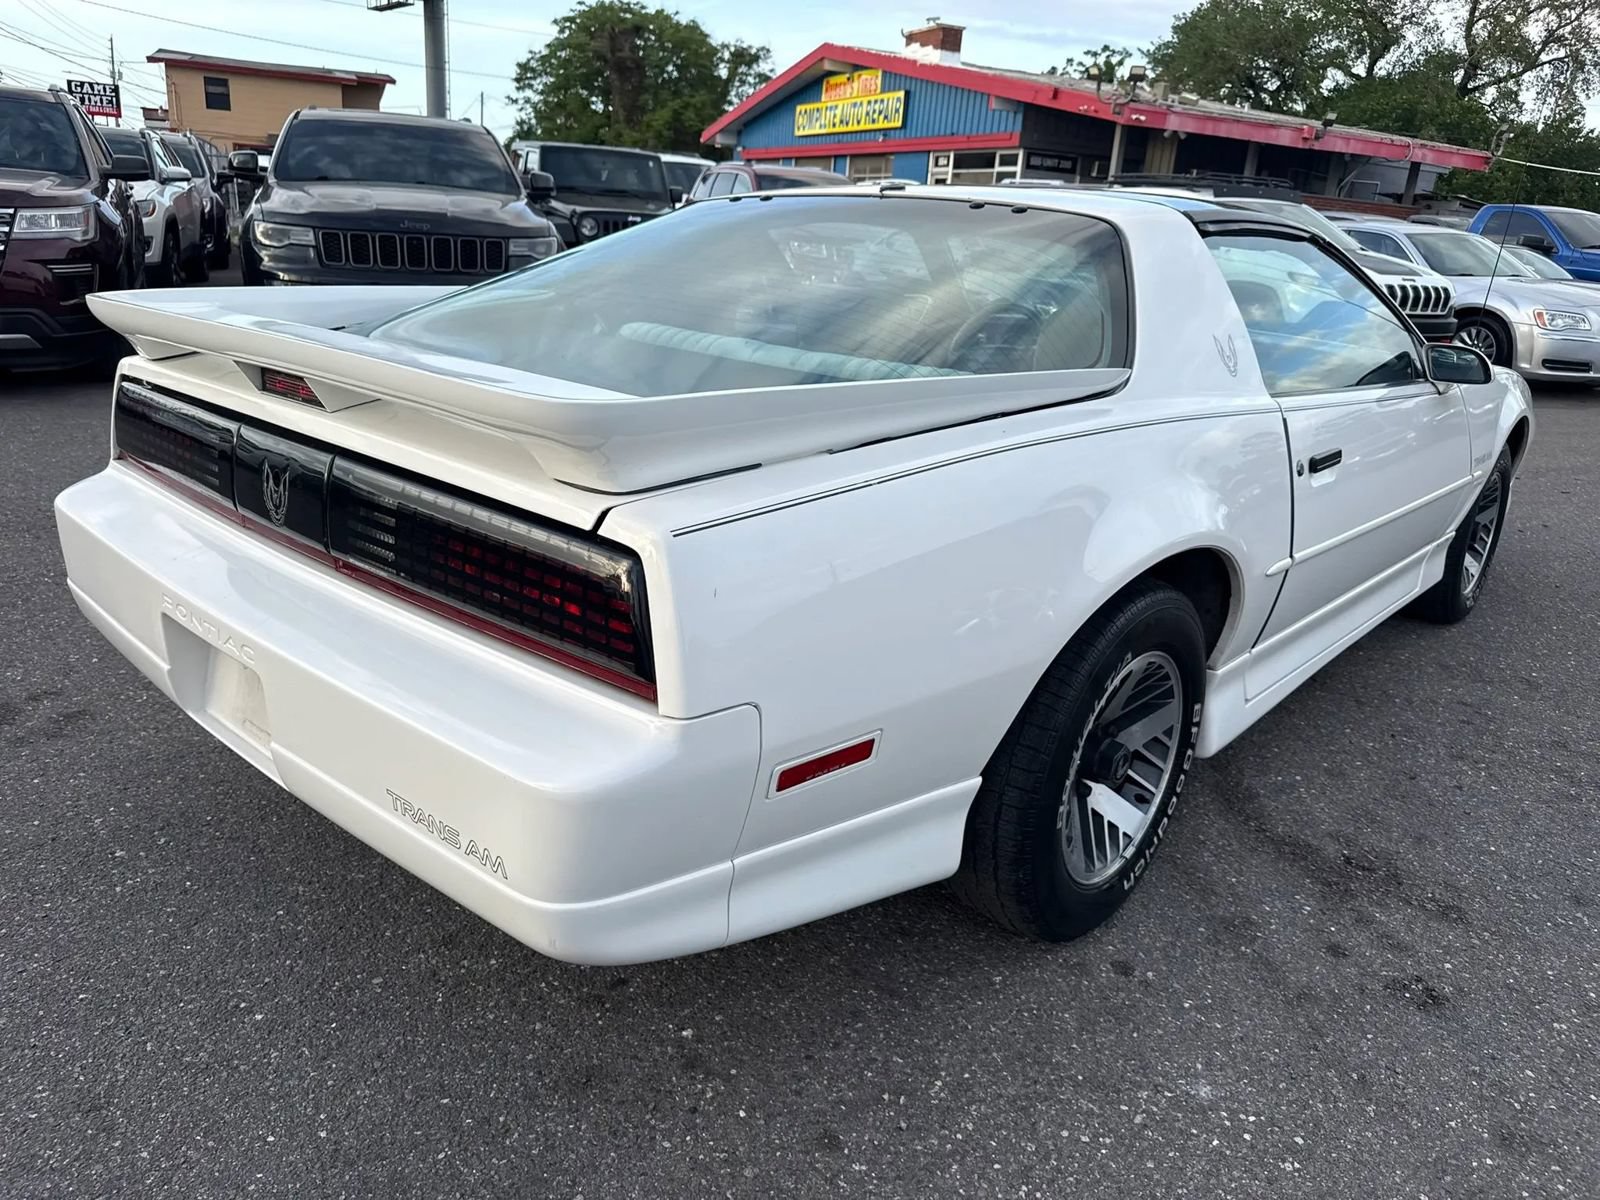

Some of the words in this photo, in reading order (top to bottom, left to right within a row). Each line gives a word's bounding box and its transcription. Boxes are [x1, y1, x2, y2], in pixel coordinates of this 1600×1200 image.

[71, 81, 116, 96] GAME
[72, 93, 117, 108] TIME!
[796, 105, 838, 132] COMPLETE
[839, 100, 863, 128] AUTO
[865, 96, 902, 126] REPAIR
[400, 219, 431, 232] Jeep
[160, 592, 256, 665] PONTIAC
[386, 788, 462, 850] TRANS
[464, 839, 508, 880] AM
